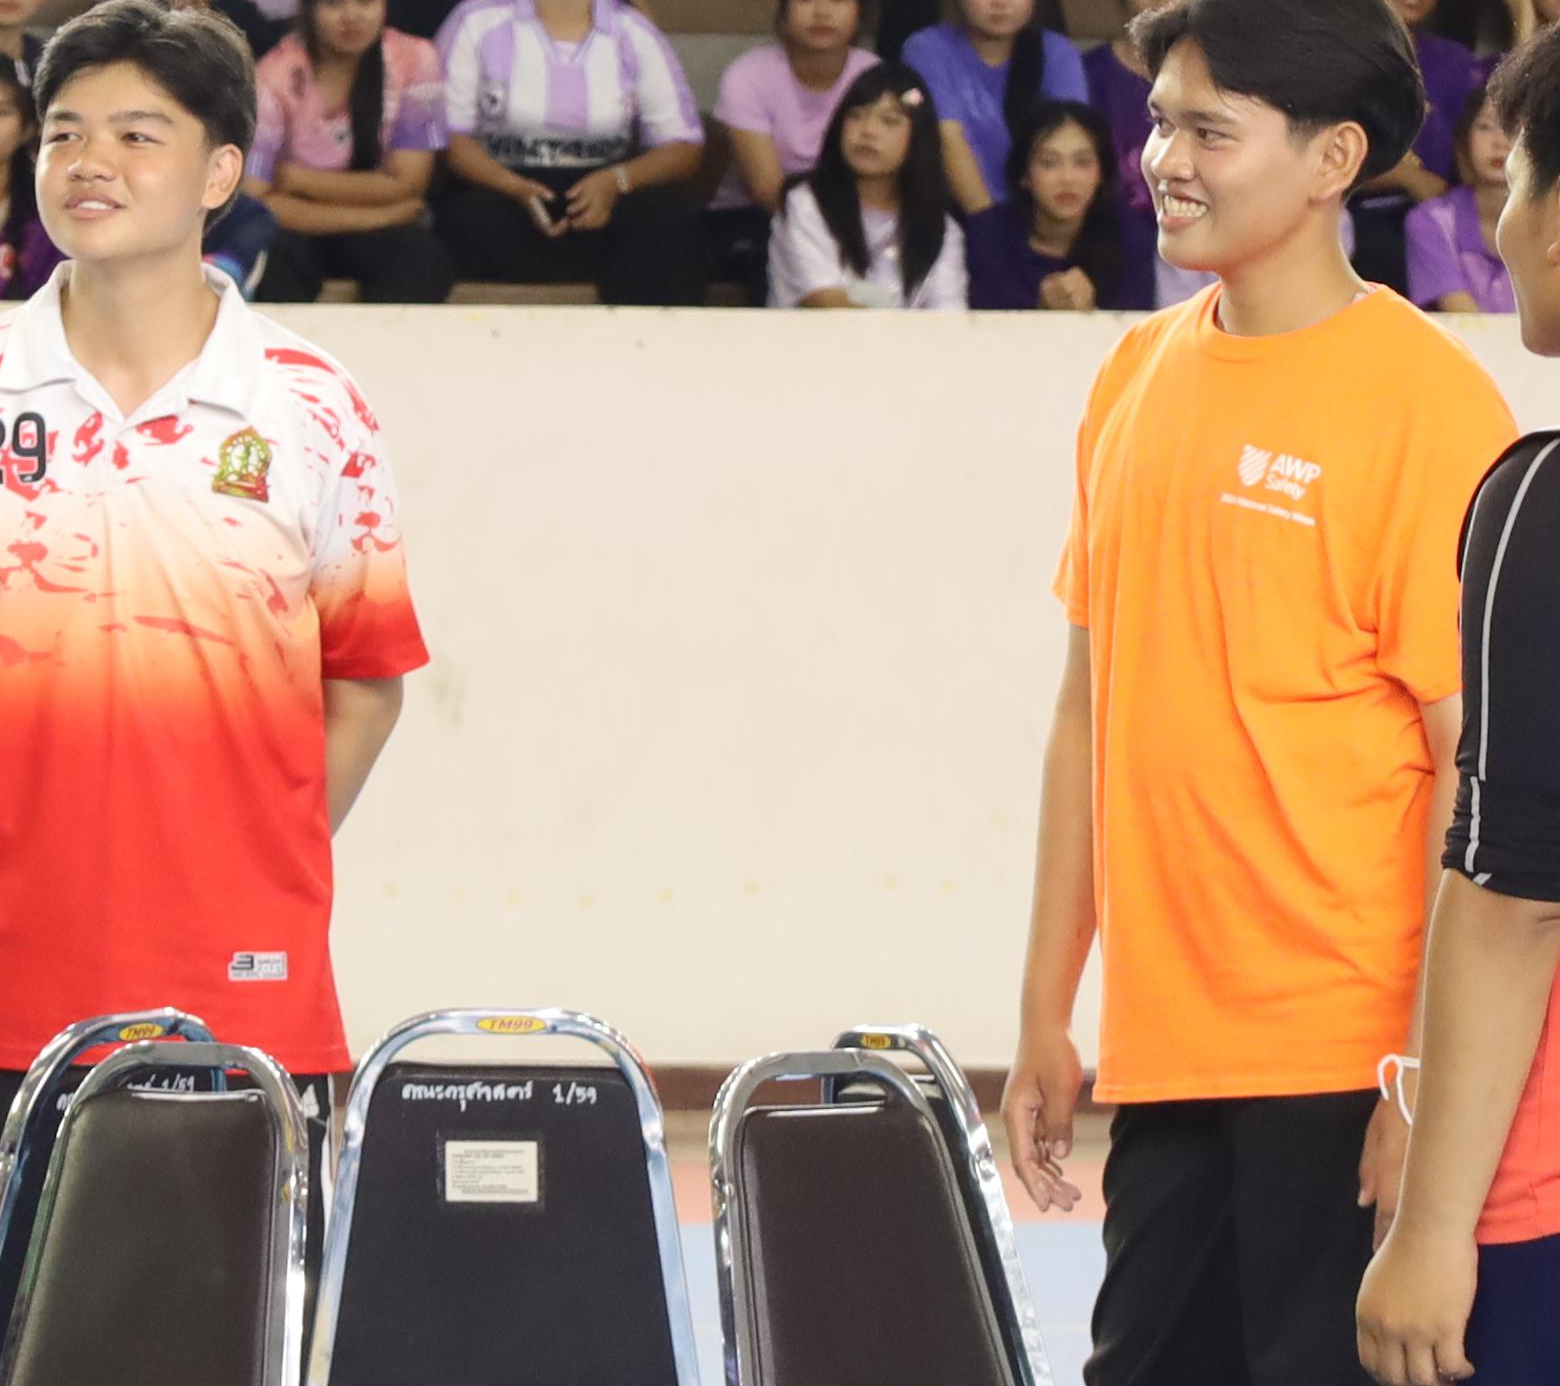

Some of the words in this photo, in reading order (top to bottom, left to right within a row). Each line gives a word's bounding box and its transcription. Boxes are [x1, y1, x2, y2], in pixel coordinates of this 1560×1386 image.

[1269, 453, 1322, 484] AWP
[1264, 474, 1307, 501] Safety
[488, 1017, 535, 1031] TM99
[552, 1081, 598, 1105] 1/59
